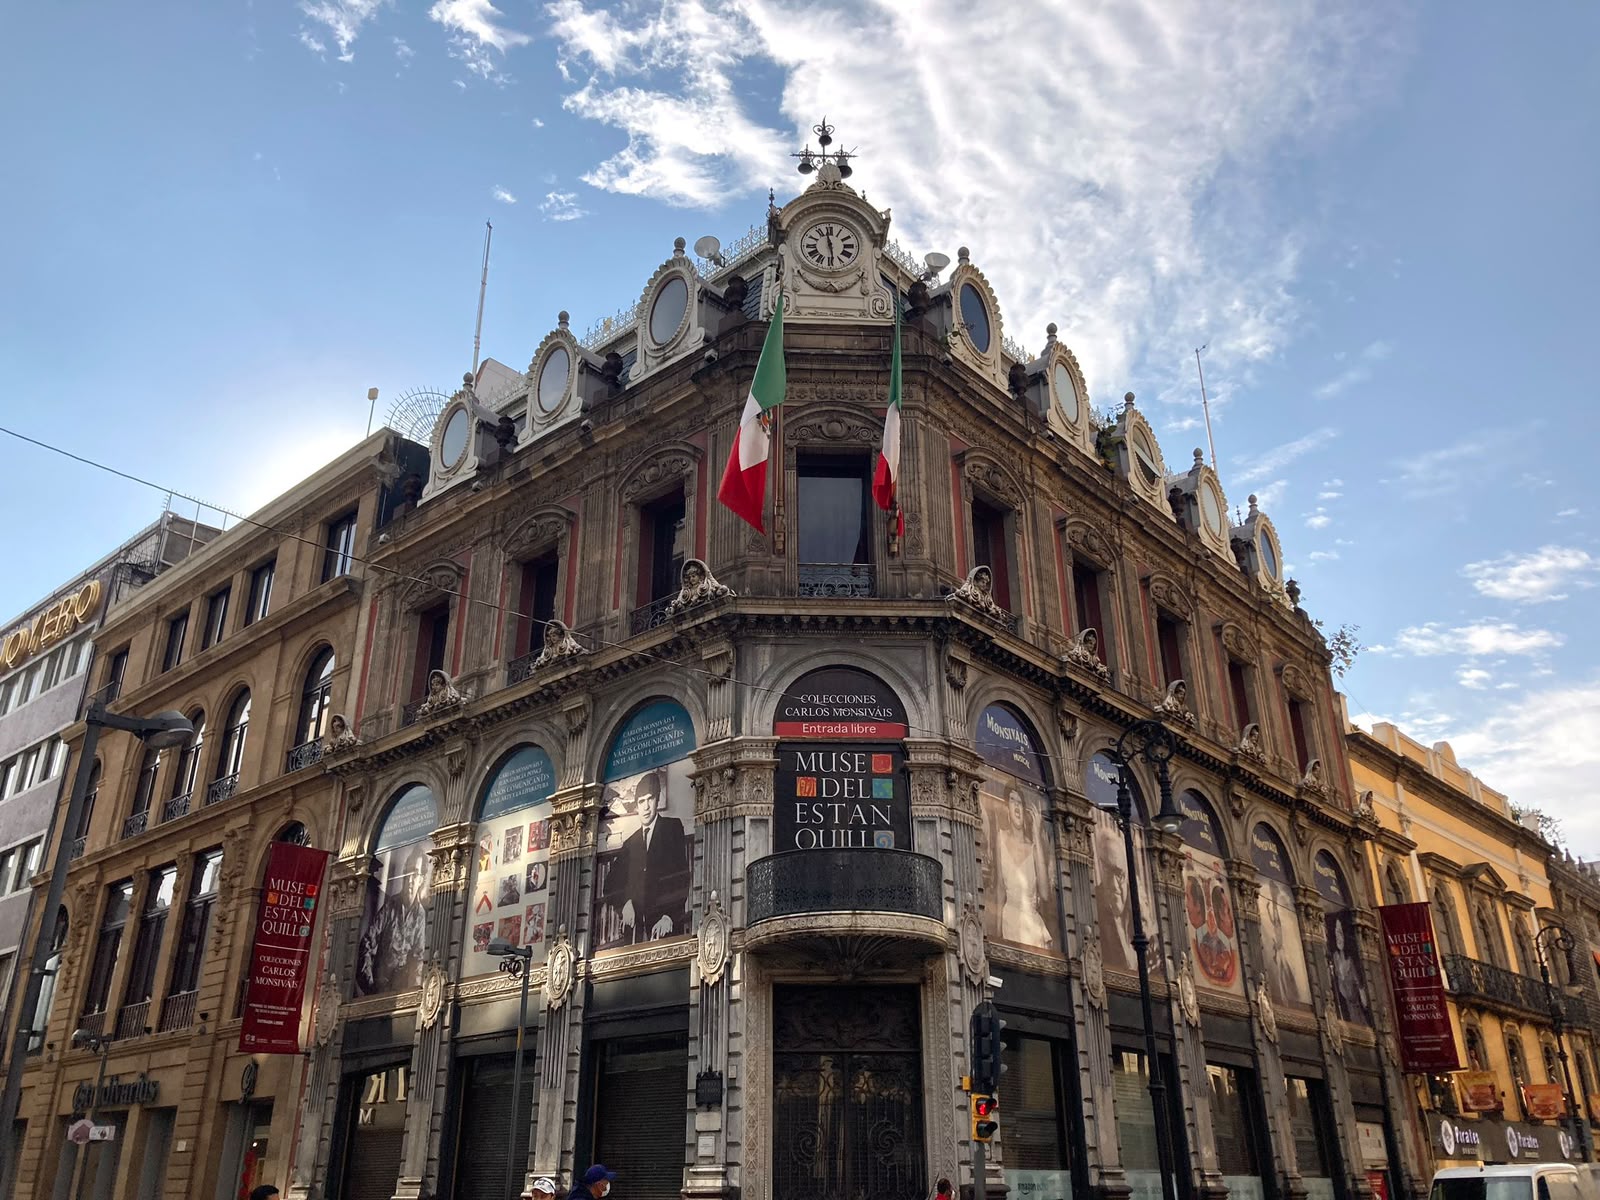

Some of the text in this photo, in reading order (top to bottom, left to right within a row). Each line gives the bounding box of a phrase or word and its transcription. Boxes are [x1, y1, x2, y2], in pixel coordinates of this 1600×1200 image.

[801, 694, 876, 704] COLECCIONES
[785, 706, 893, 718] CARLOS MONSIVÁIS
[802, 723, 877, 734] Entrada libre
[821, 778, 870, 798] DEL
[795, 802, 891, 825] ESTAN
[279, 894, 303, 908] DEL
[264, 905, 312, 924] ESTAN
[1400, 944, 1424, 956] DEL
[262, 965, 296, 978] CARLOS
